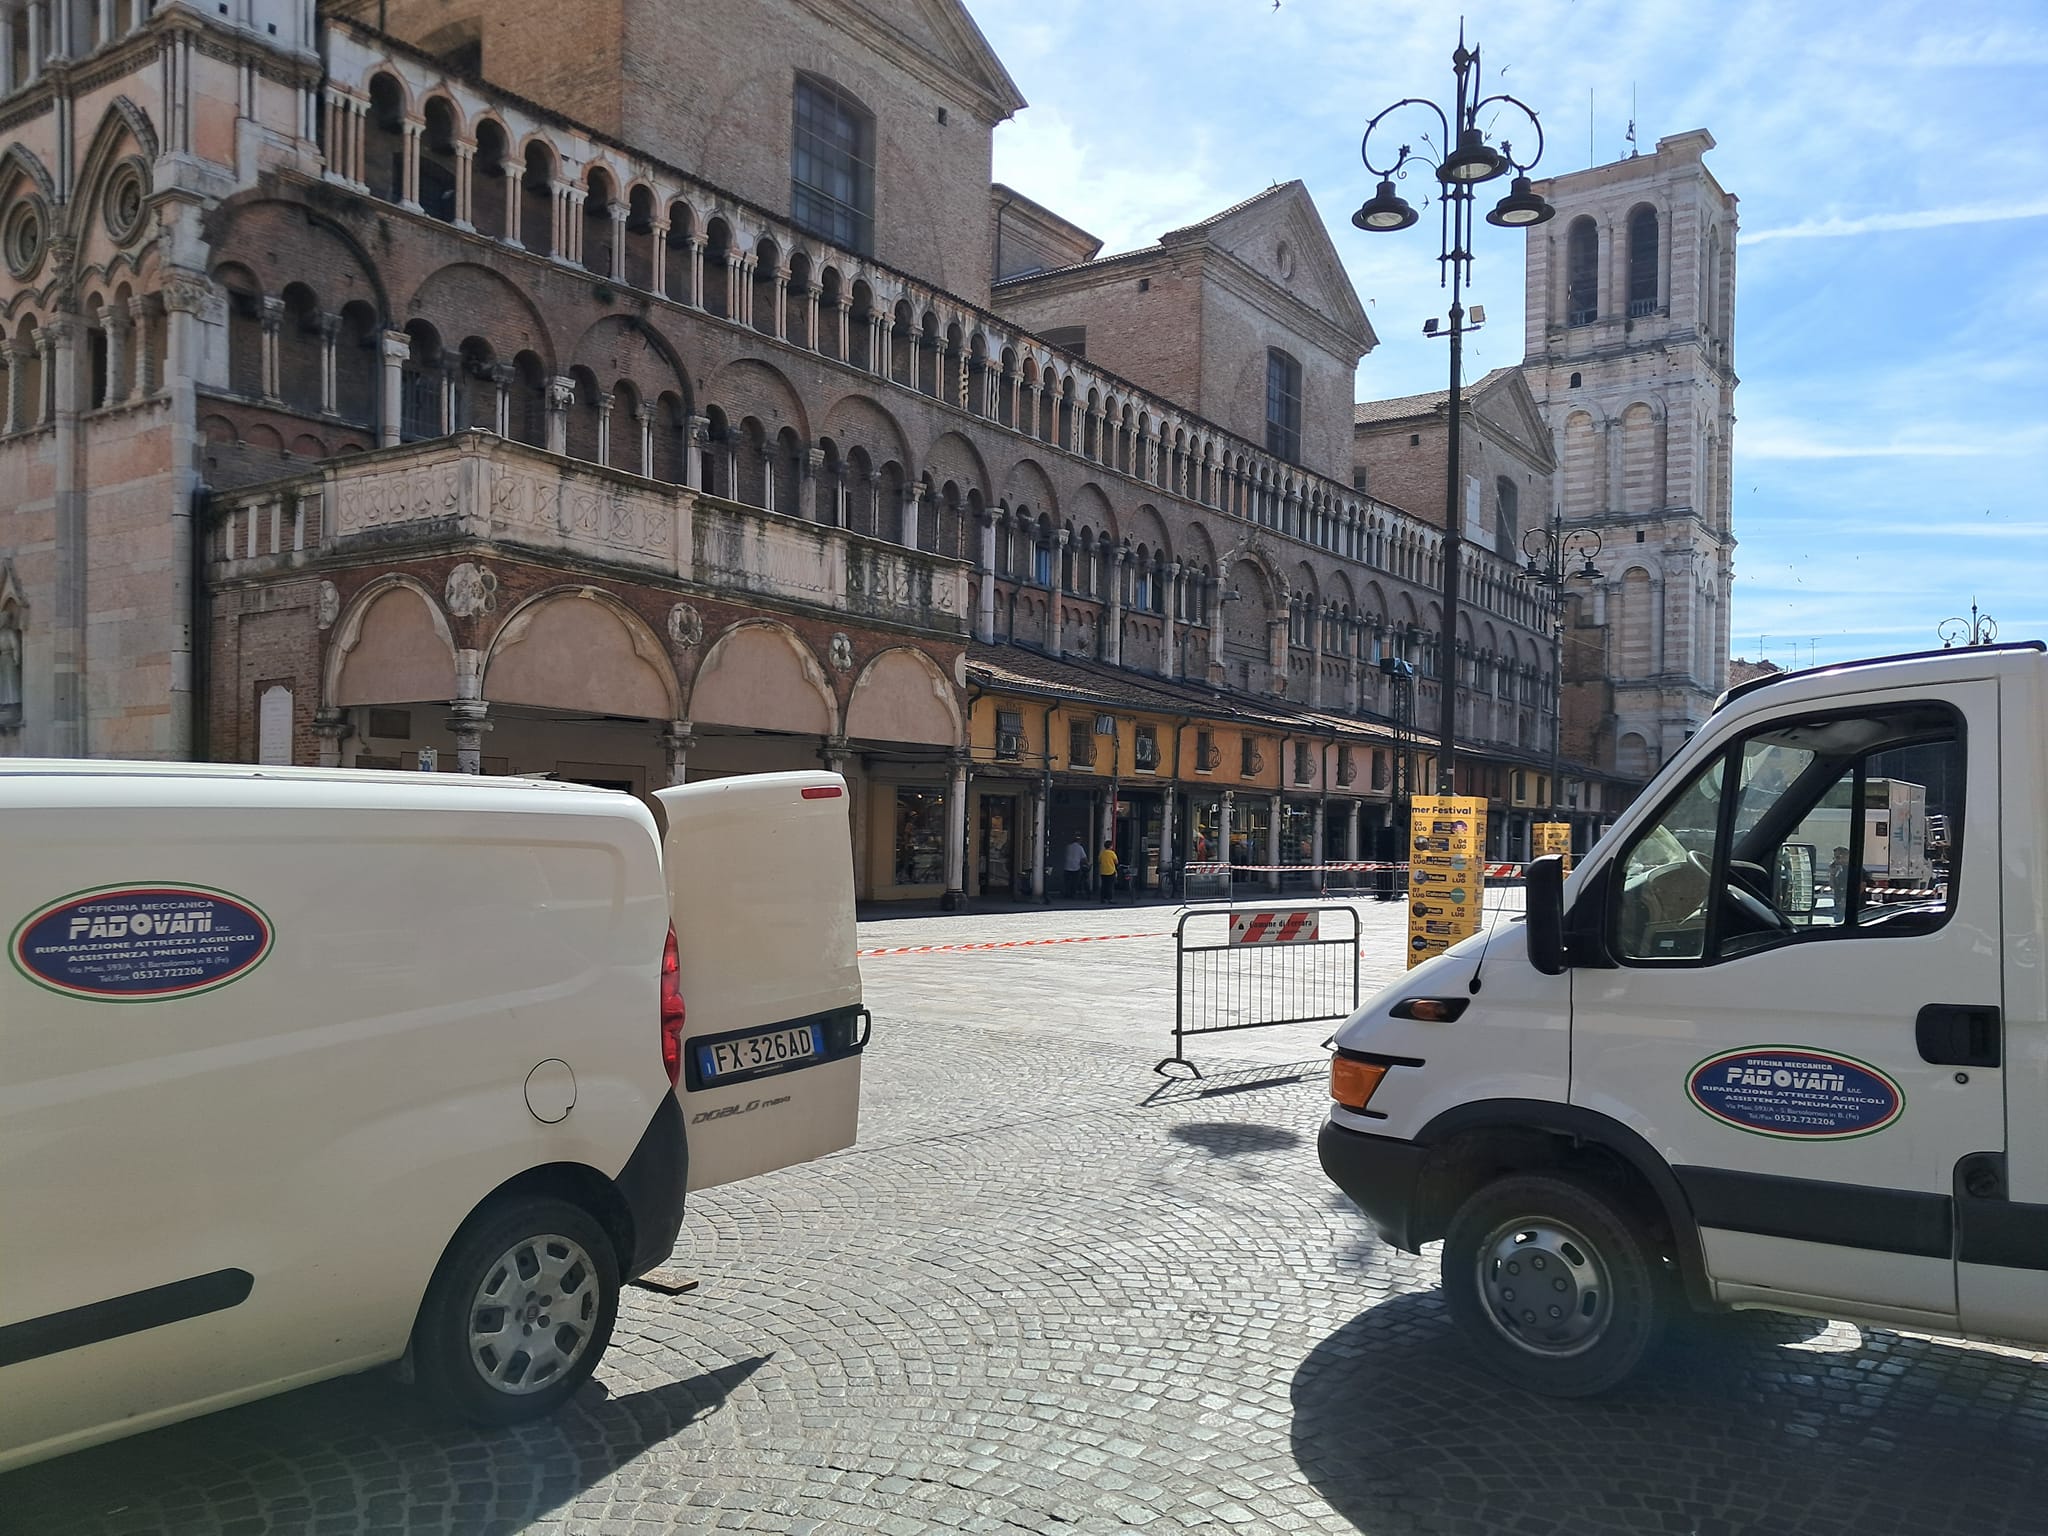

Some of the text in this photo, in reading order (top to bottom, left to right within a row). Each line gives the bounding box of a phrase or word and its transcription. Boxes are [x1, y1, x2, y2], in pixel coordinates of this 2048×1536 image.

[1432, 806, 1472, 814] Festival
[78, 901, 214, 914] OFFICINA MECCANICA
[69, 911, 213, 940] PADOVANI
[35, 935, 255, 954] RIPARAZIONE ATTREZZI AGRICOLI
[67, 946, 229, 962] ASSISTENZA PNEUMATICI
[132, 966, 204, 980] 0532.722206
[714, 1030, 812, 1073] FX 326AD
[1747, 1059, 1833, 1071] OFFICINA MECCANICA
[1726, 1067, 1845, 1092] PADOVANI
[1702, 1085, 1885, 1105] RIPARAZIONE ATTREZZI AGRICOLI
[1725, 1095, 1860, 1111] ASSISTENZA PNEUMATICI
[1774, 1114, 1836, 1126] 0532.722206
